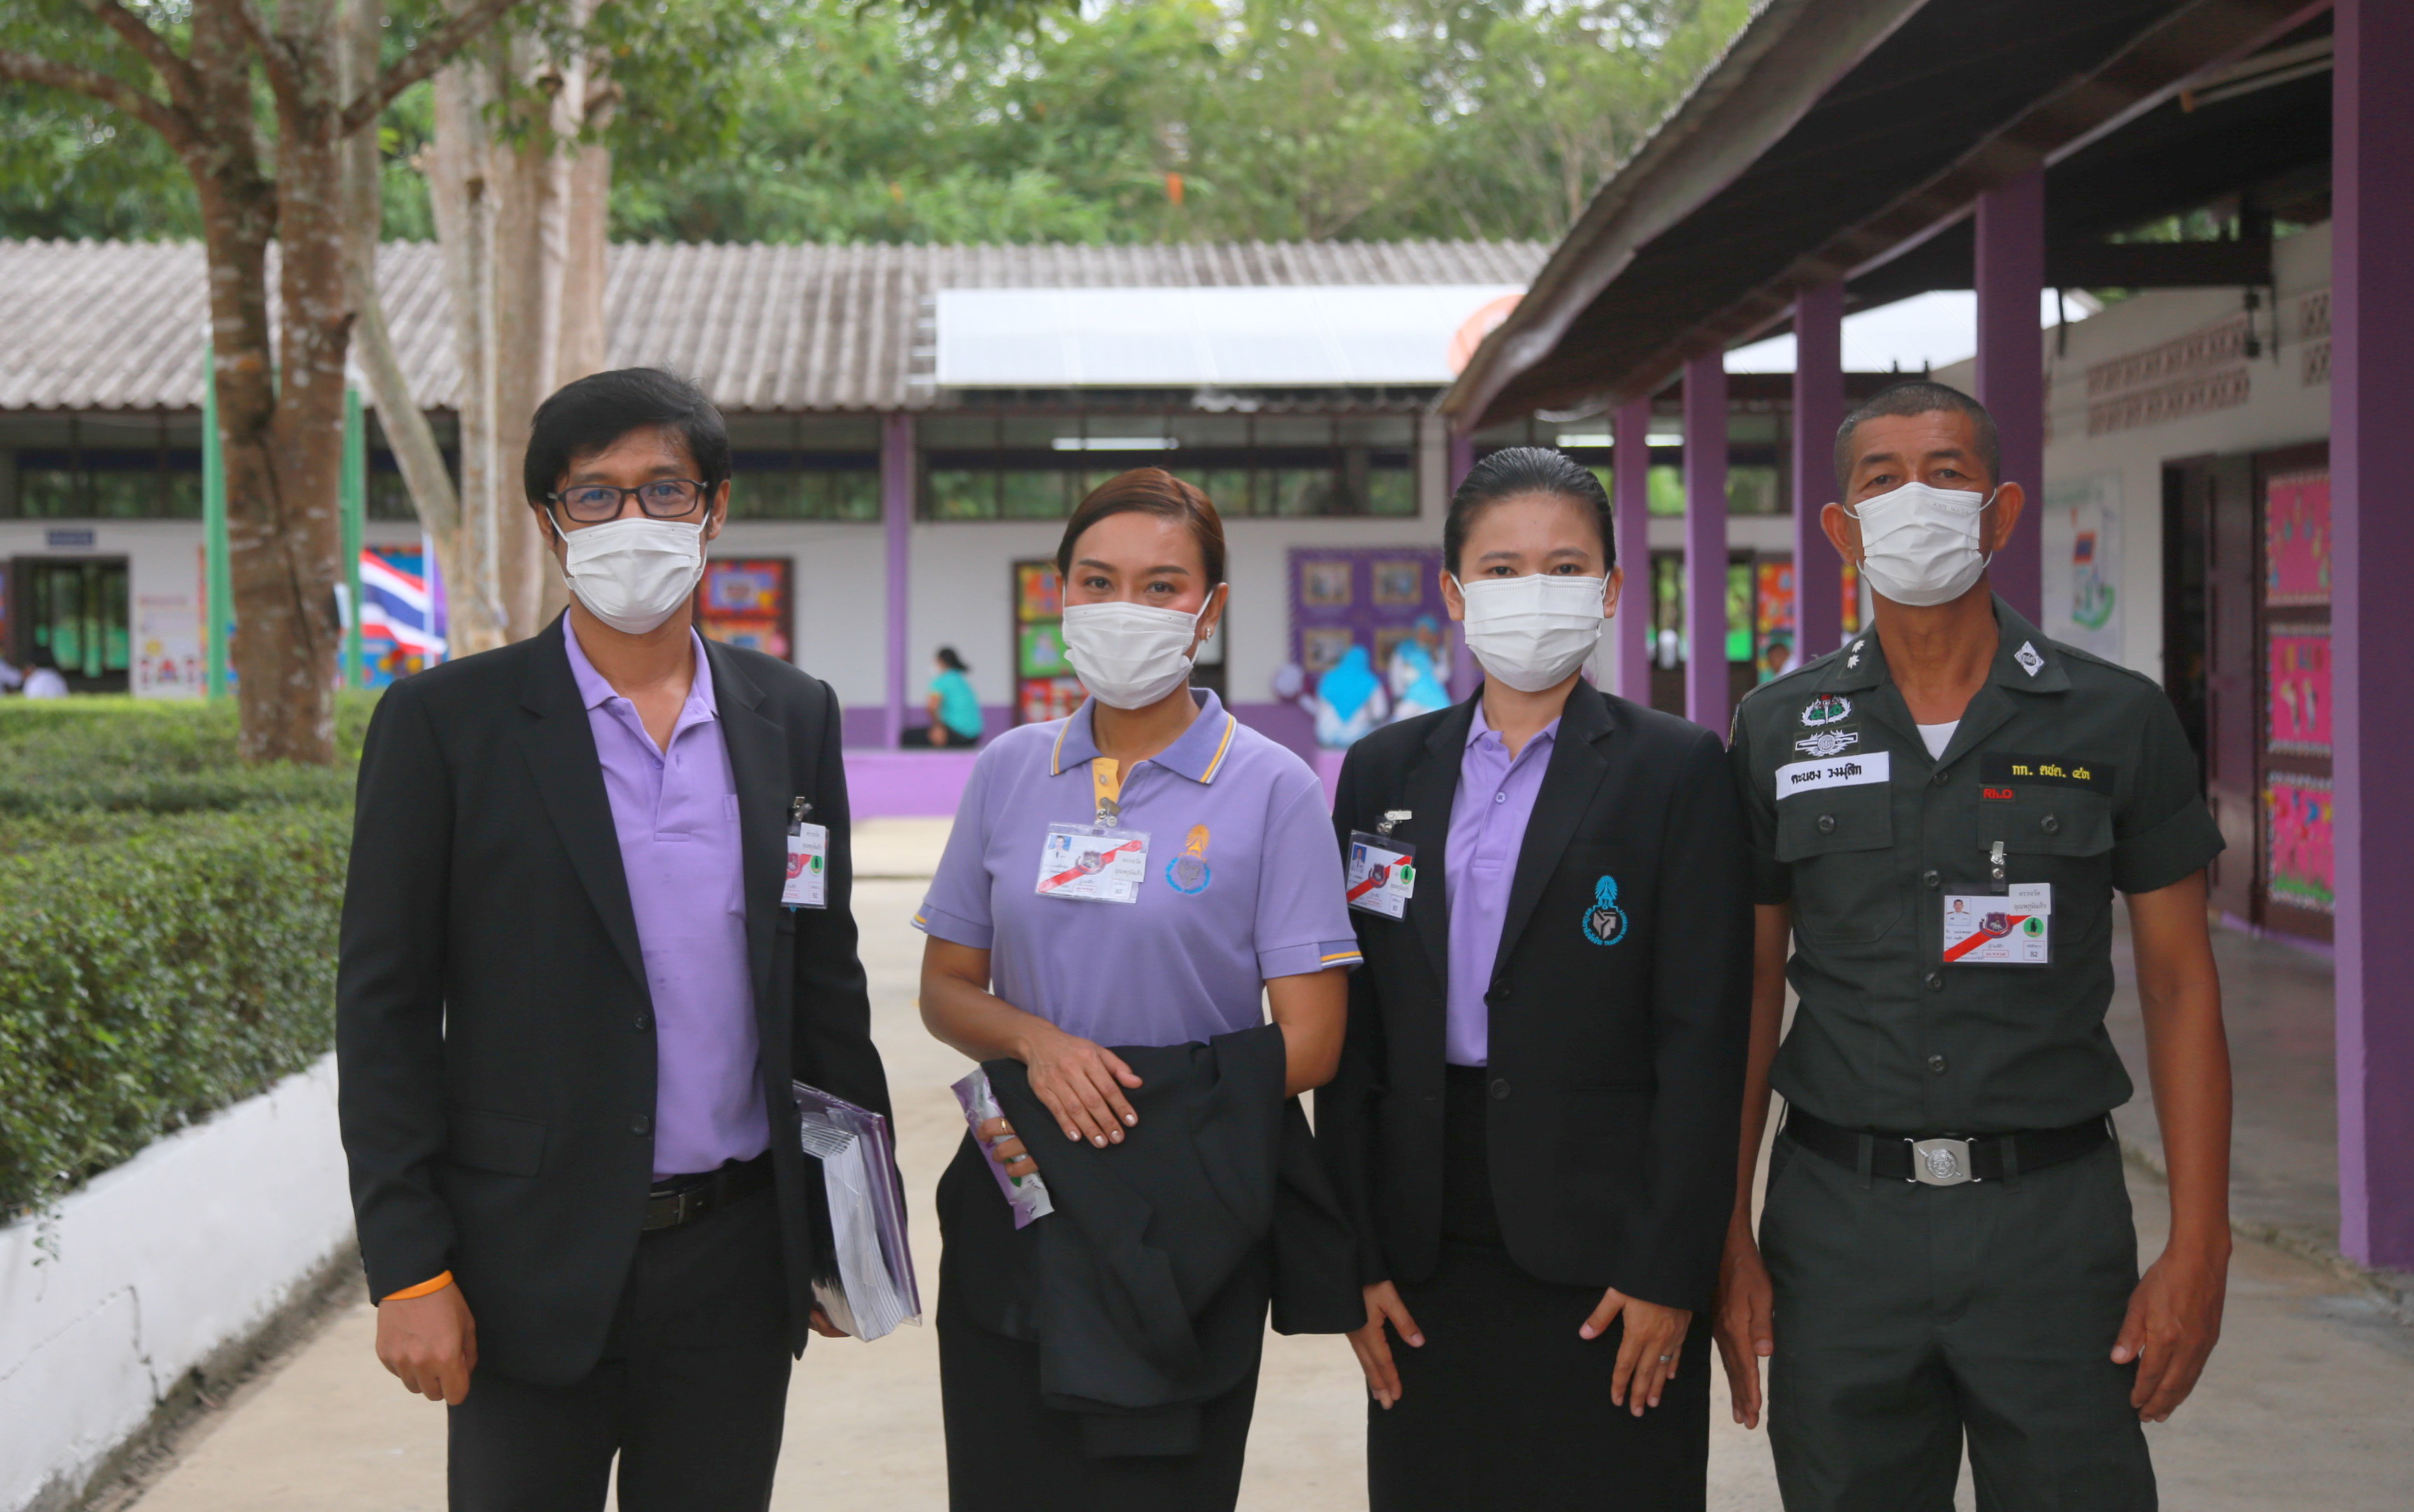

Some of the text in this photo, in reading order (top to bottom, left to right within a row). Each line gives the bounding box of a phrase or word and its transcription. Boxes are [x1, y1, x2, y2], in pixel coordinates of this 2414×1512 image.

[2012, 765, 2034, 776] กก.
[2013, 902, 2046, 911] อุณหภูมิแล้ว
